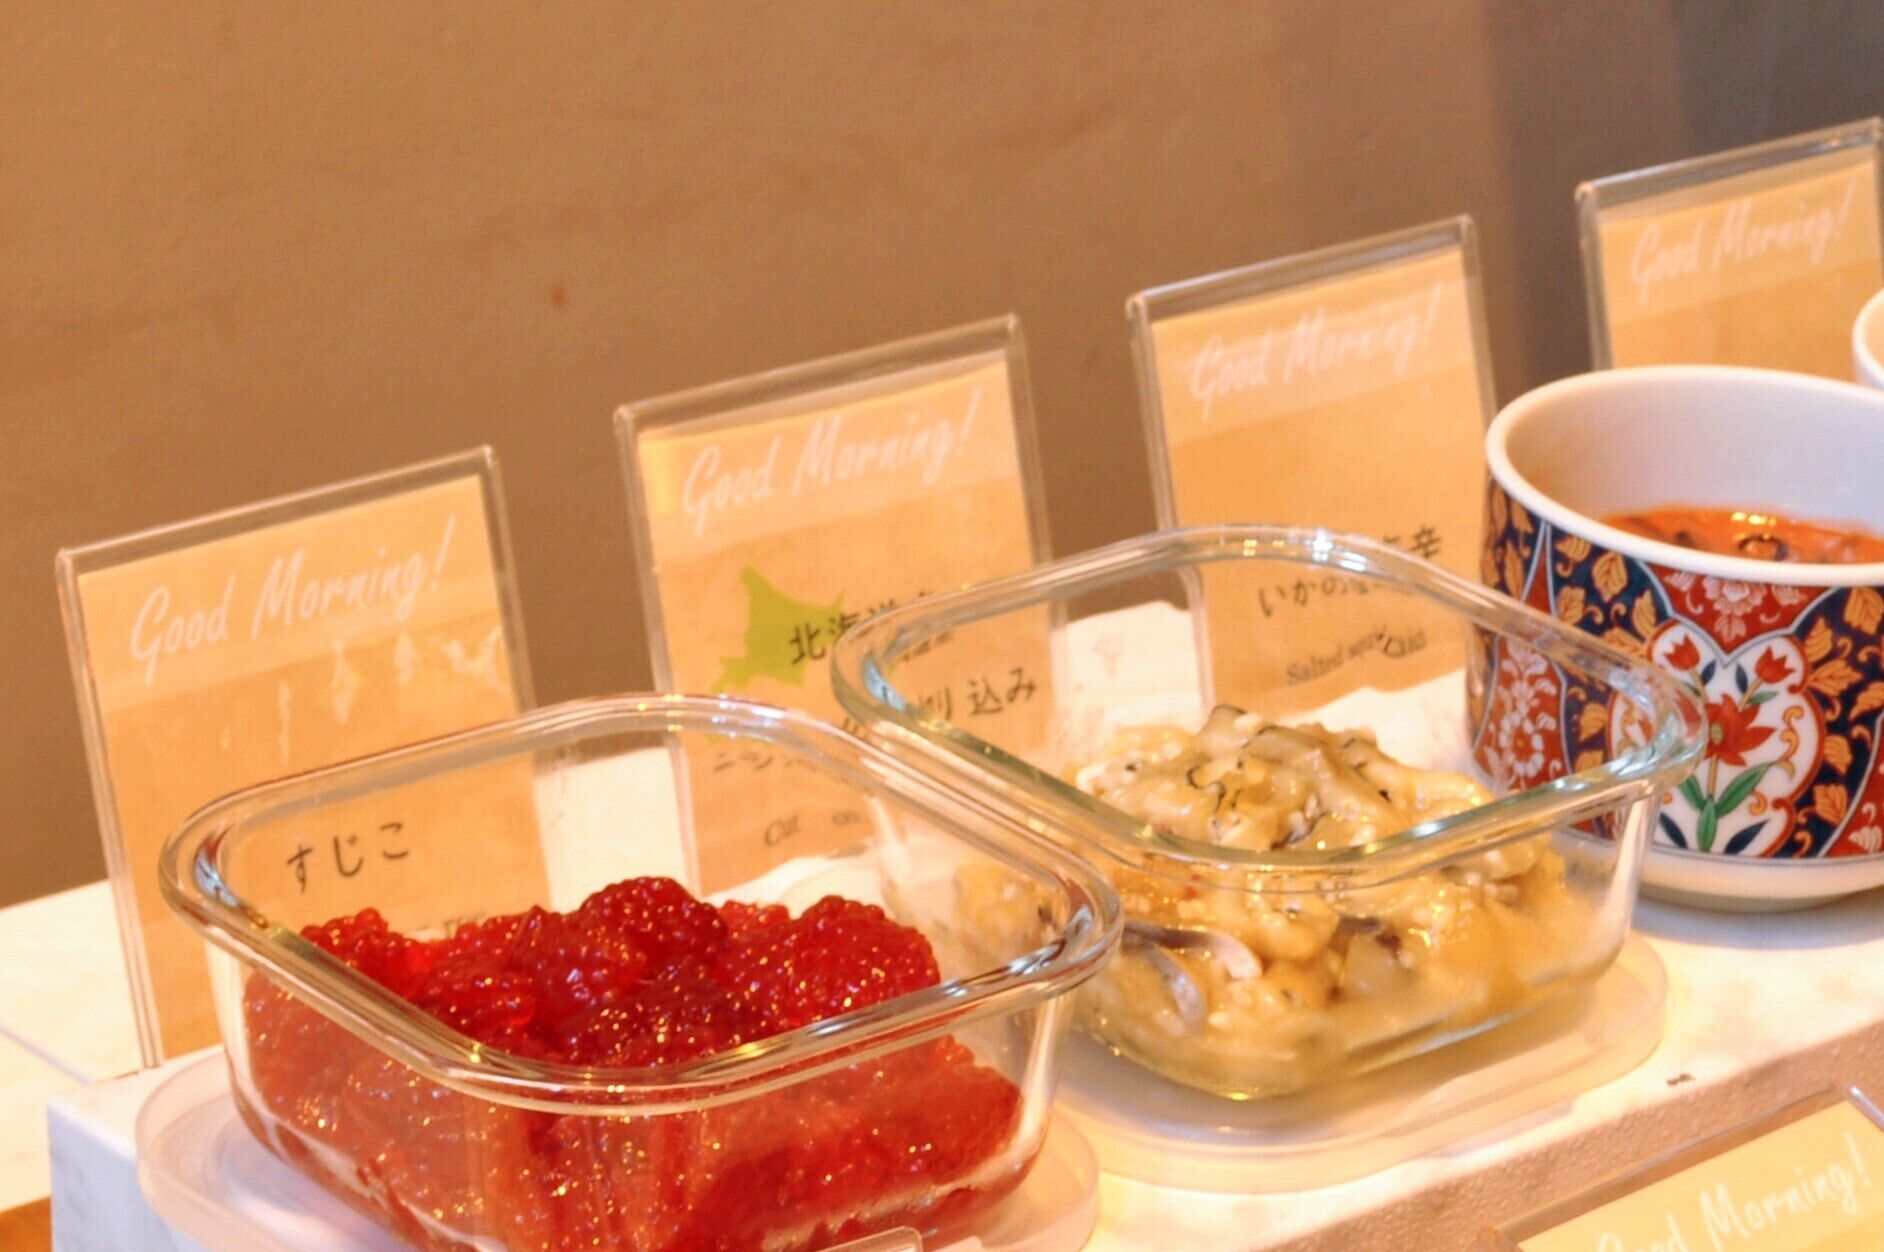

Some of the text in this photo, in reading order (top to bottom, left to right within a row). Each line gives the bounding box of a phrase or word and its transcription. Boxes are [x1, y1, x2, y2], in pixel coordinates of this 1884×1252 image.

[1630, 218, 1705, 306] Good
[1190, 336, 1270, 423] Good
[683, 387, 982, 536] Good Morning!
[129, 516, 455, 684] Good Morning!
[285, 820, 412, 895] すじこ
[1704, 1133, 1873, 1252] Morning!
